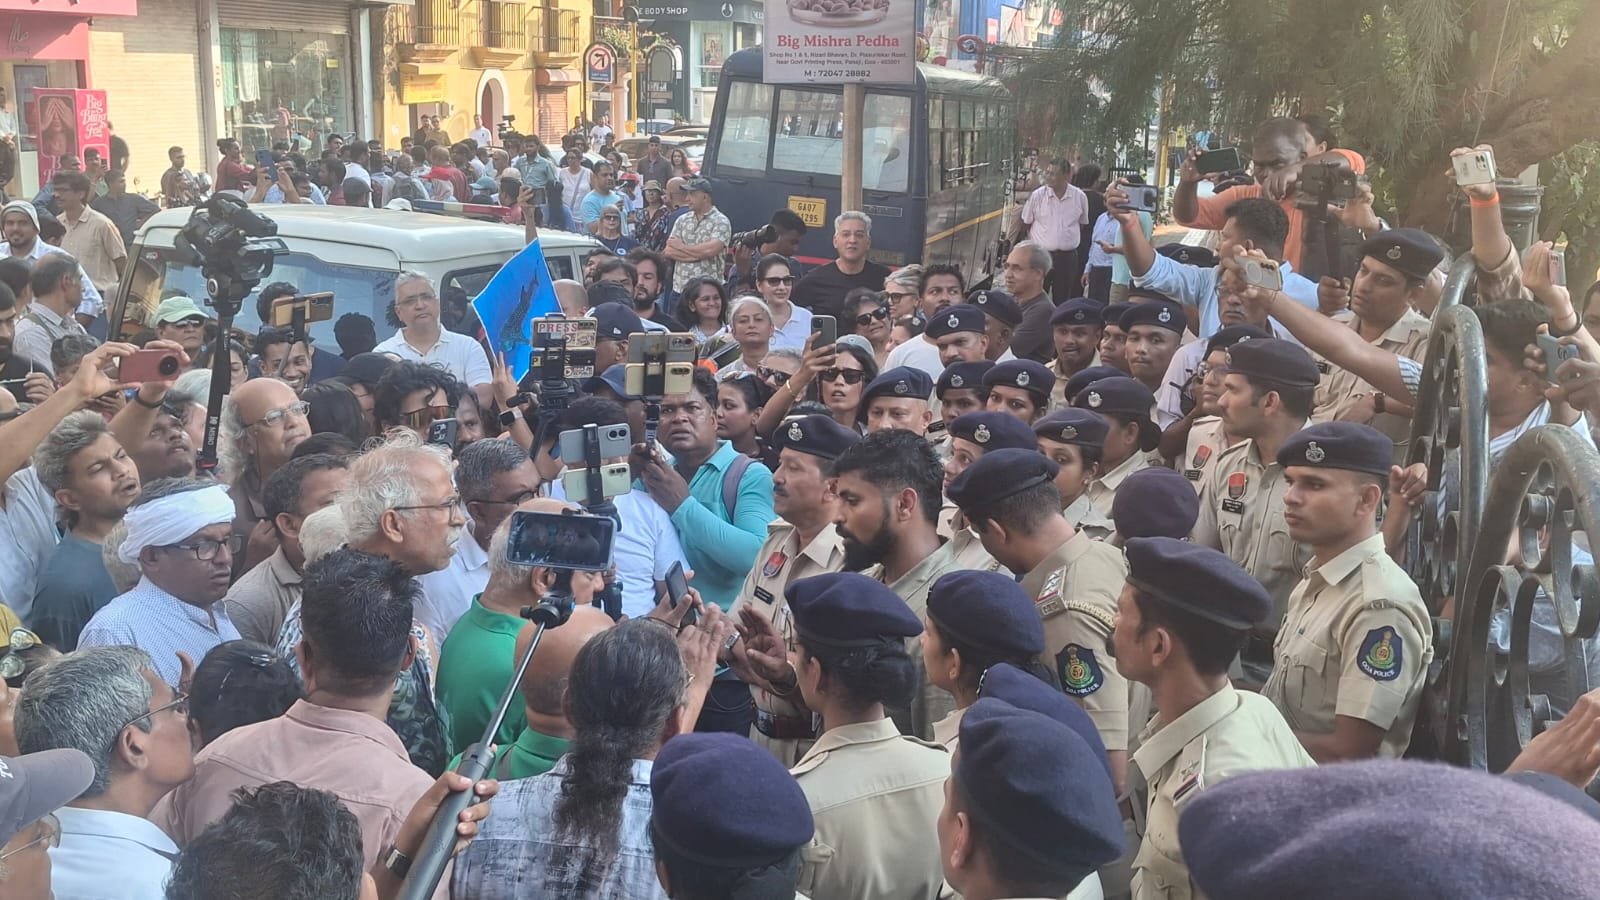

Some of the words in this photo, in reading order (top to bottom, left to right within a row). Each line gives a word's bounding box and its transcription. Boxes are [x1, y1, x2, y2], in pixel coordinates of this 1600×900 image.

[645, 7, 665, 15] BODY
[666, 7, 688, 15] SHOP
[777, 34, 800, 50] Big
[804, 34, 851, 47] Mishra
[856, 34, 899, 47] Pedha
[86, 94, 104, 112] Big
[80, 109, 107, 129] Bling
[798, 202, 817, 212] GA07
[539, 323, 578, 333] PRESS
[1373, 670, 1396, 678] POLICE
